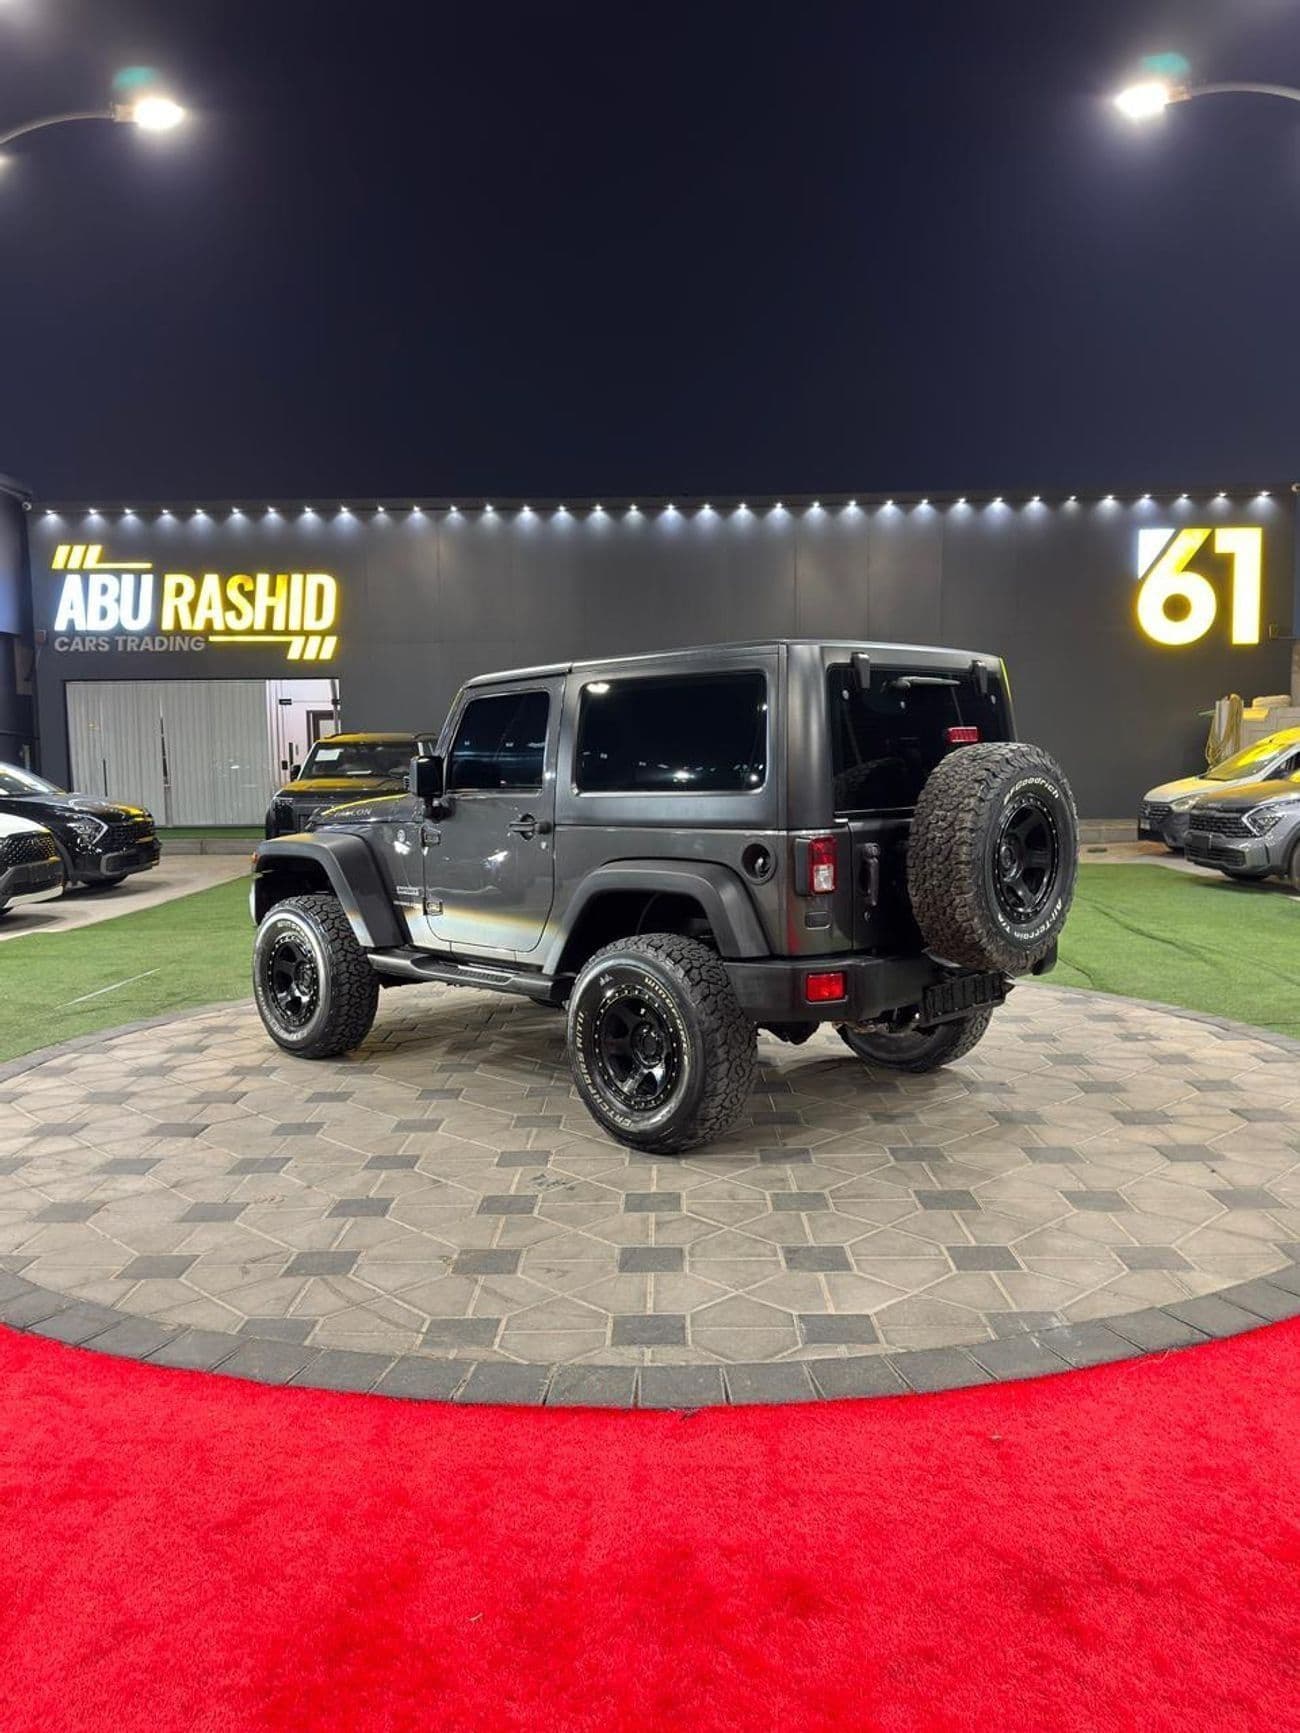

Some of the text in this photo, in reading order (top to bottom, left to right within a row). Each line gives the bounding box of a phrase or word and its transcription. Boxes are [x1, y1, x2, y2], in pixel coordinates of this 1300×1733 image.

[54, 574, 337, 631] ABU RASHID
[1137, 527, 1262, 645] 61
[54, 635, 205, 652] CARS TRADING
